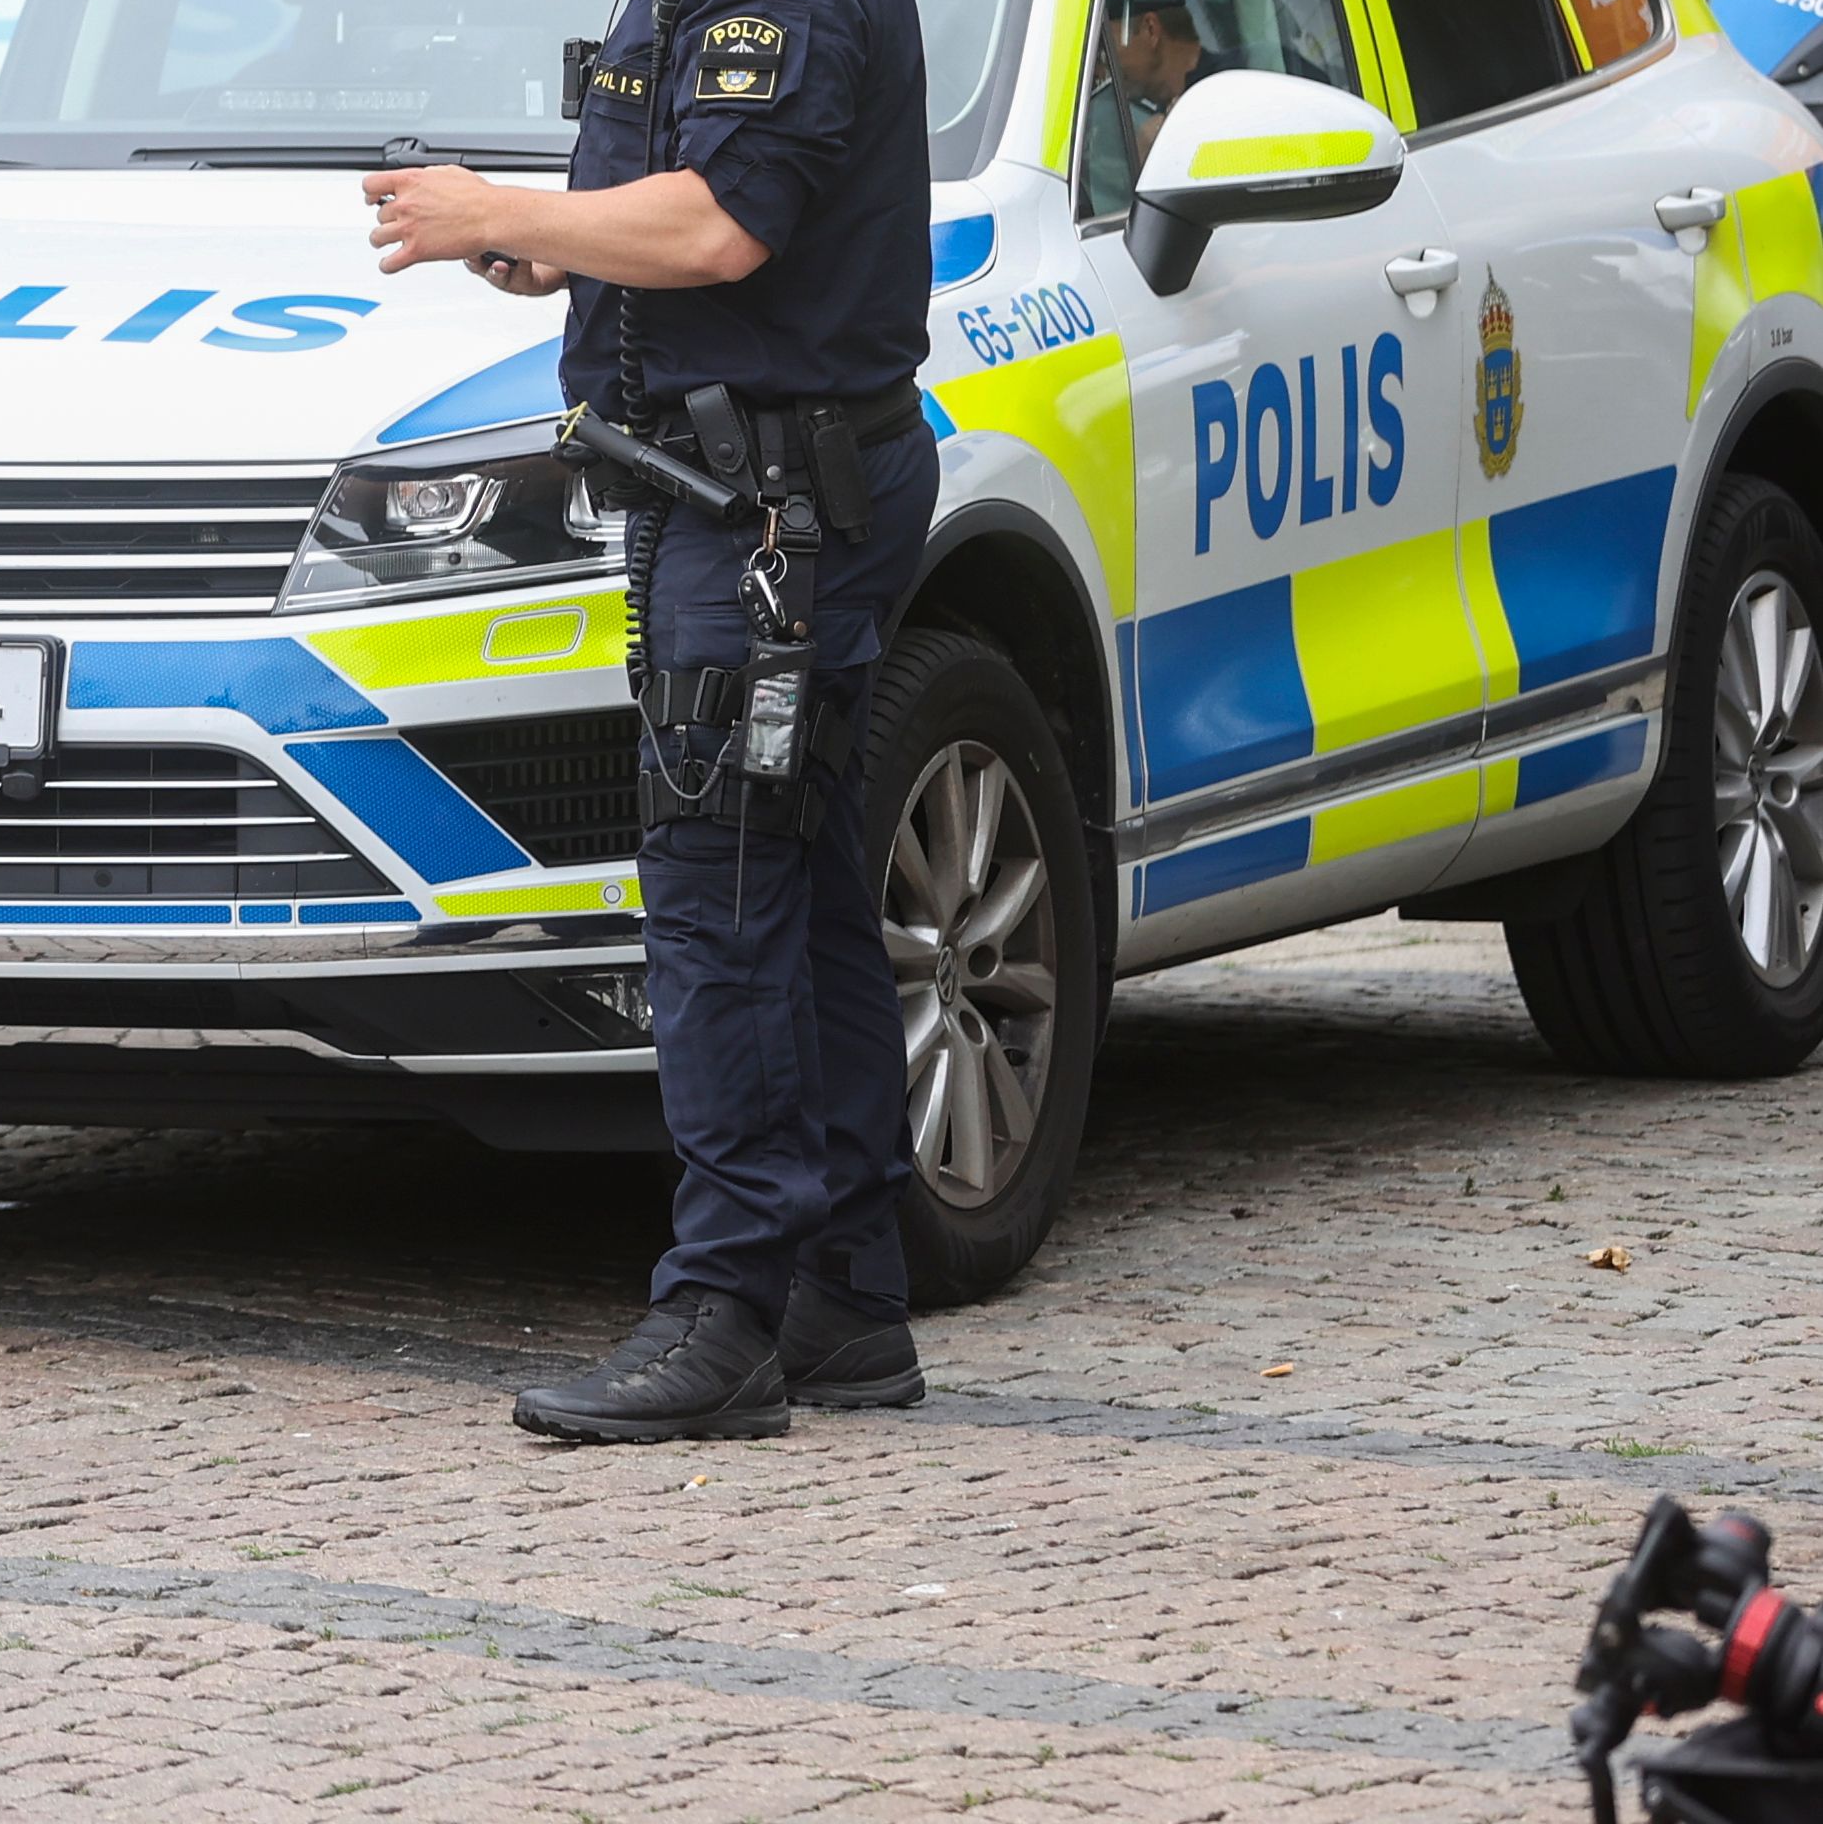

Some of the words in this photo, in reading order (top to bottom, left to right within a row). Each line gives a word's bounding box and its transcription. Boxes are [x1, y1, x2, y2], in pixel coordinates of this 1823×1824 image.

[712, 23, 776, 46] POLIS
[957, 283, 1095, 366] 65-1200
[1192, 332, 1405, 556] POLIS
